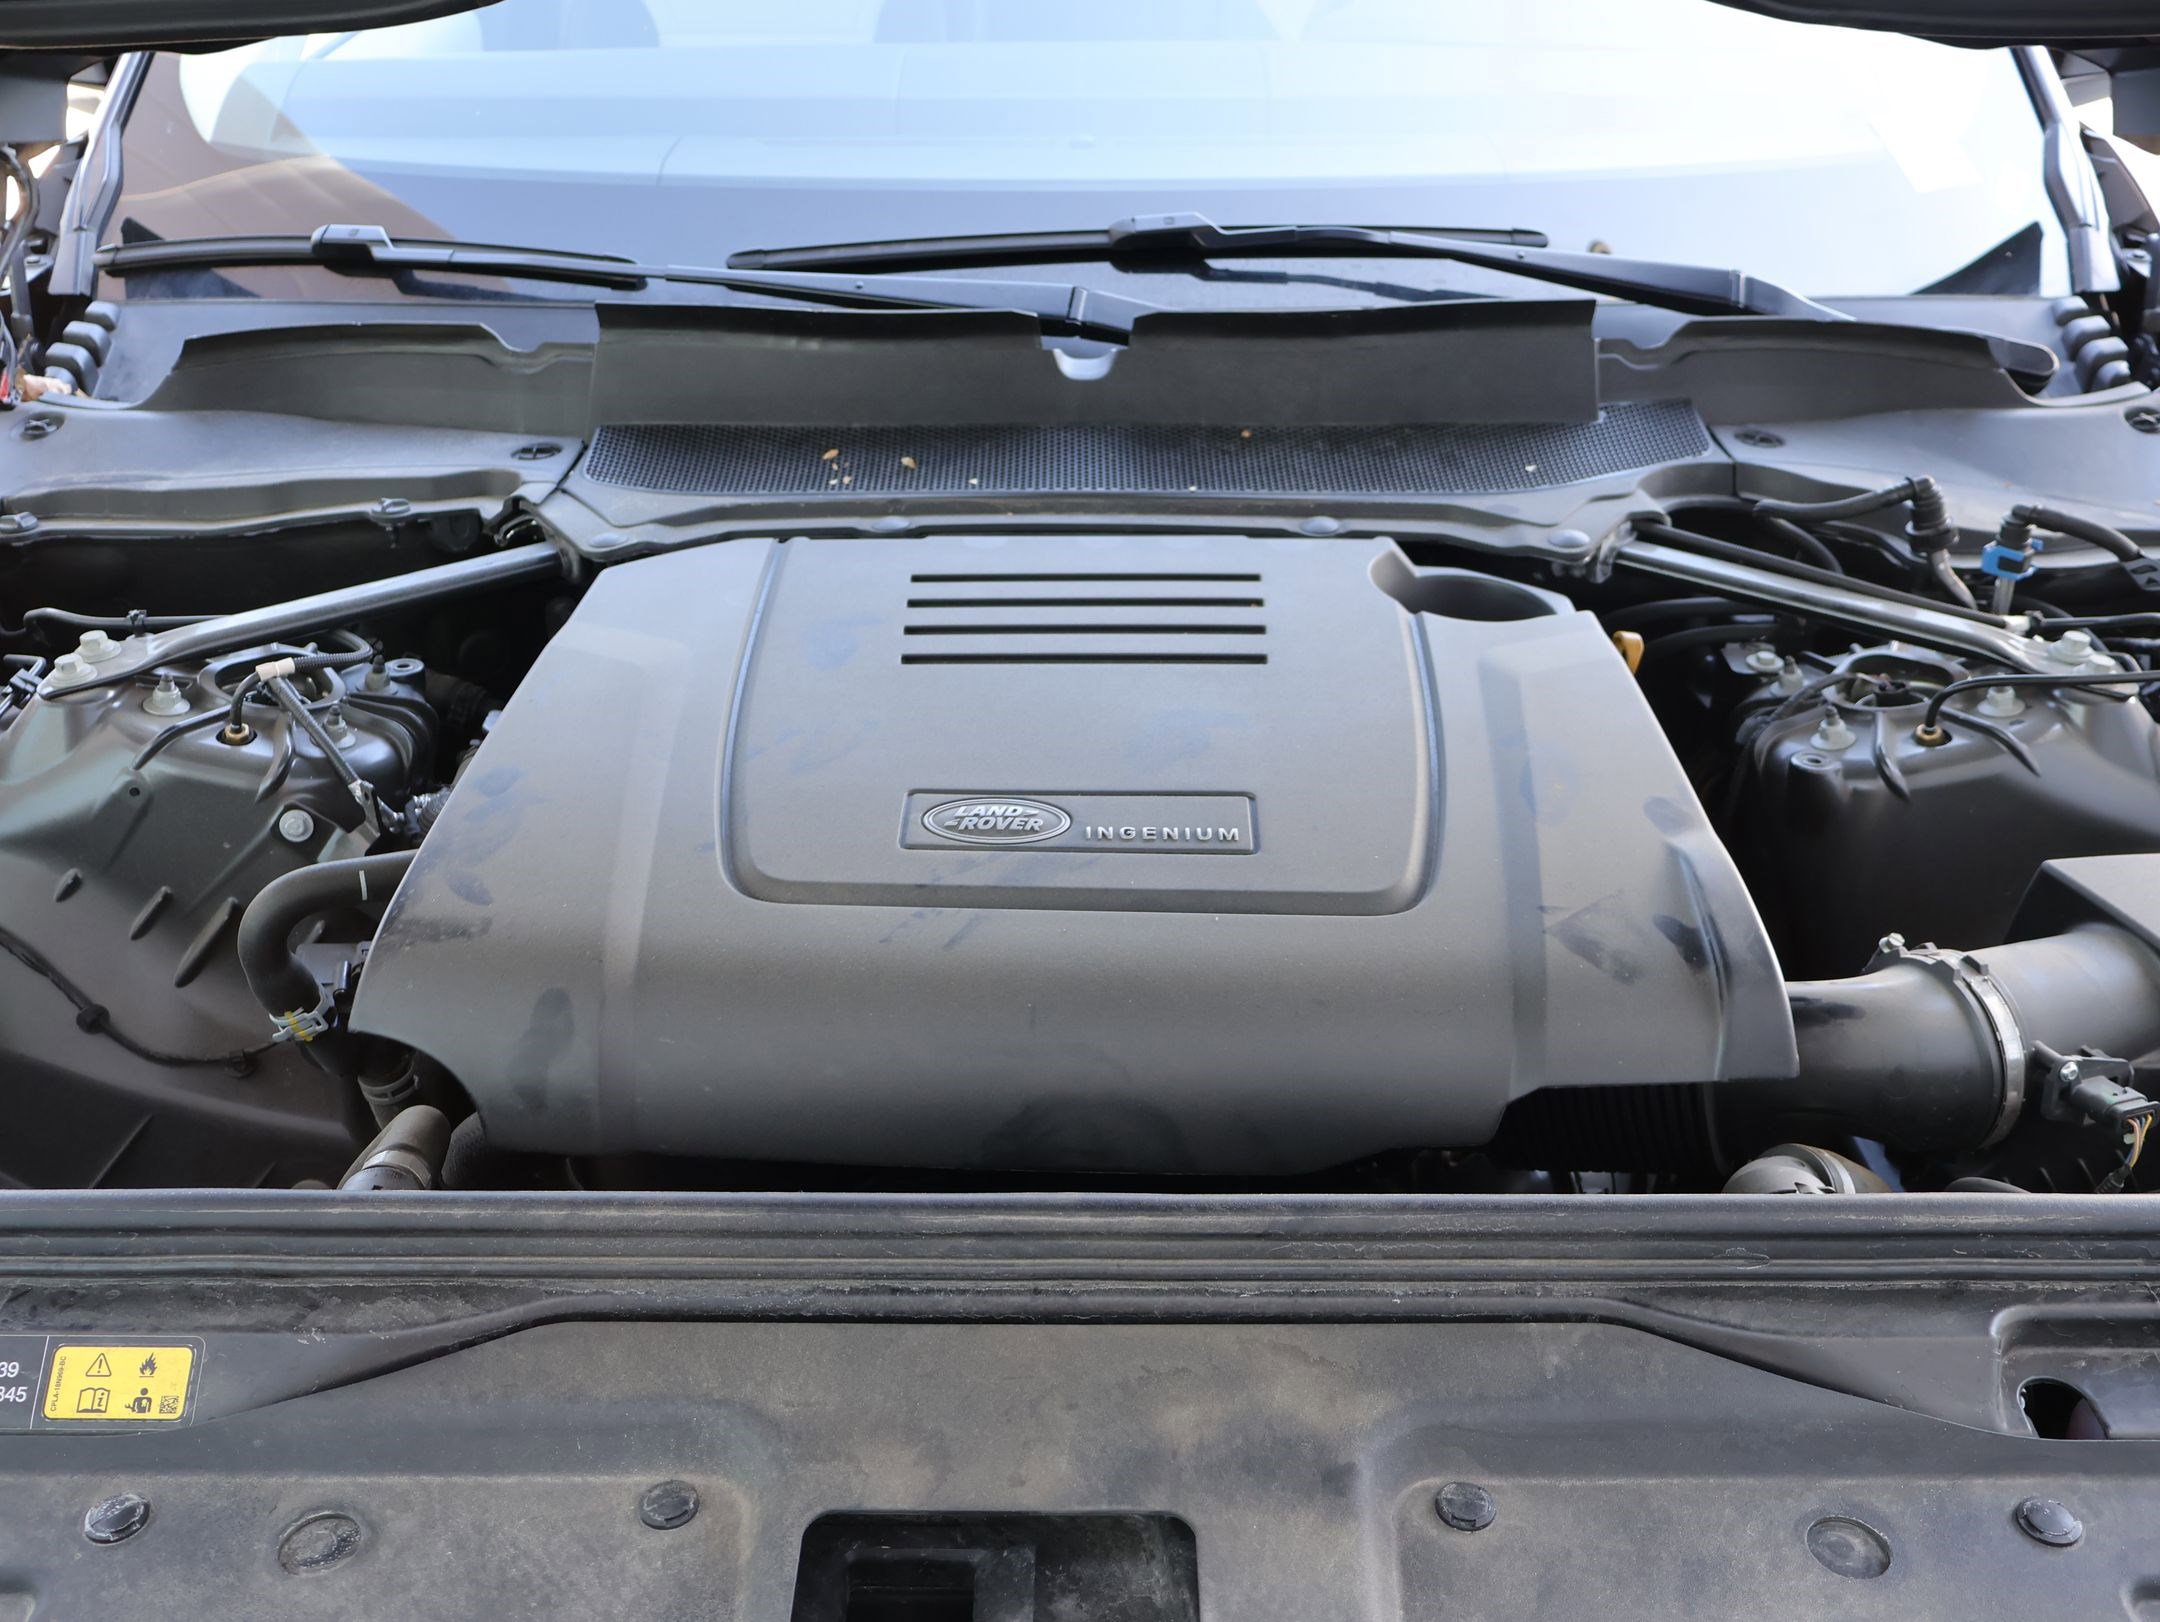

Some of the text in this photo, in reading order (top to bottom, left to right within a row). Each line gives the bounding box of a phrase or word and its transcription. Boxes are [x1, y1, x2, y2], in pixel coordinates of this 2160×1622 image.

[952, 806, 1024, 817] LAND
[958, 816, 1044, 832] ROVER
[1085, 826, 1240, 842] INGENIUM
